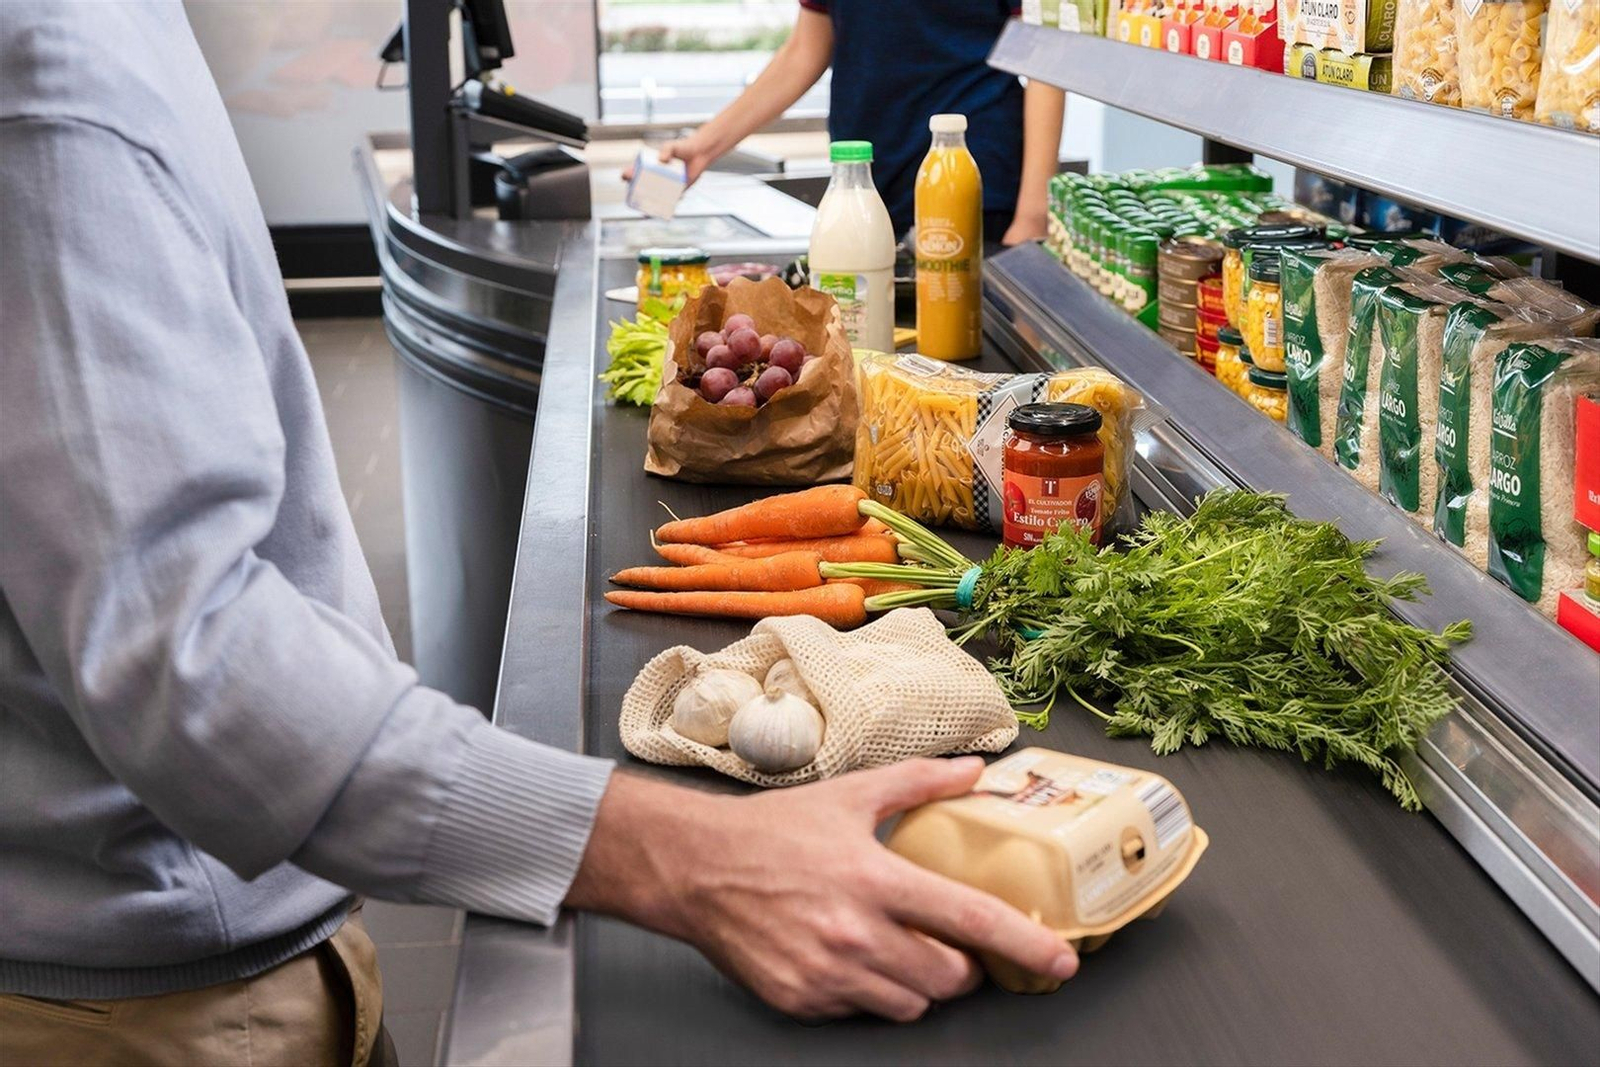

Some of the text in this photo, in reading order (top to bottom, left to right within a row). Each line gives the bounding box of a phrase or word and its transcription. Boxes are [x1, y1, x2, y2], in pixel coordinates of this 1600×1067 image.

[1318, 3, 1338, 19] CLARO
[1336, 66, 1353, 82] CLARO
[1381, 391, 1406, 418] LARGO
[1036, 499, 1073, 507] CULTIVADOR
[1013, 511, 1044, 527] Estilo
[1030, 507, 1070, 516] Tomate Frito
